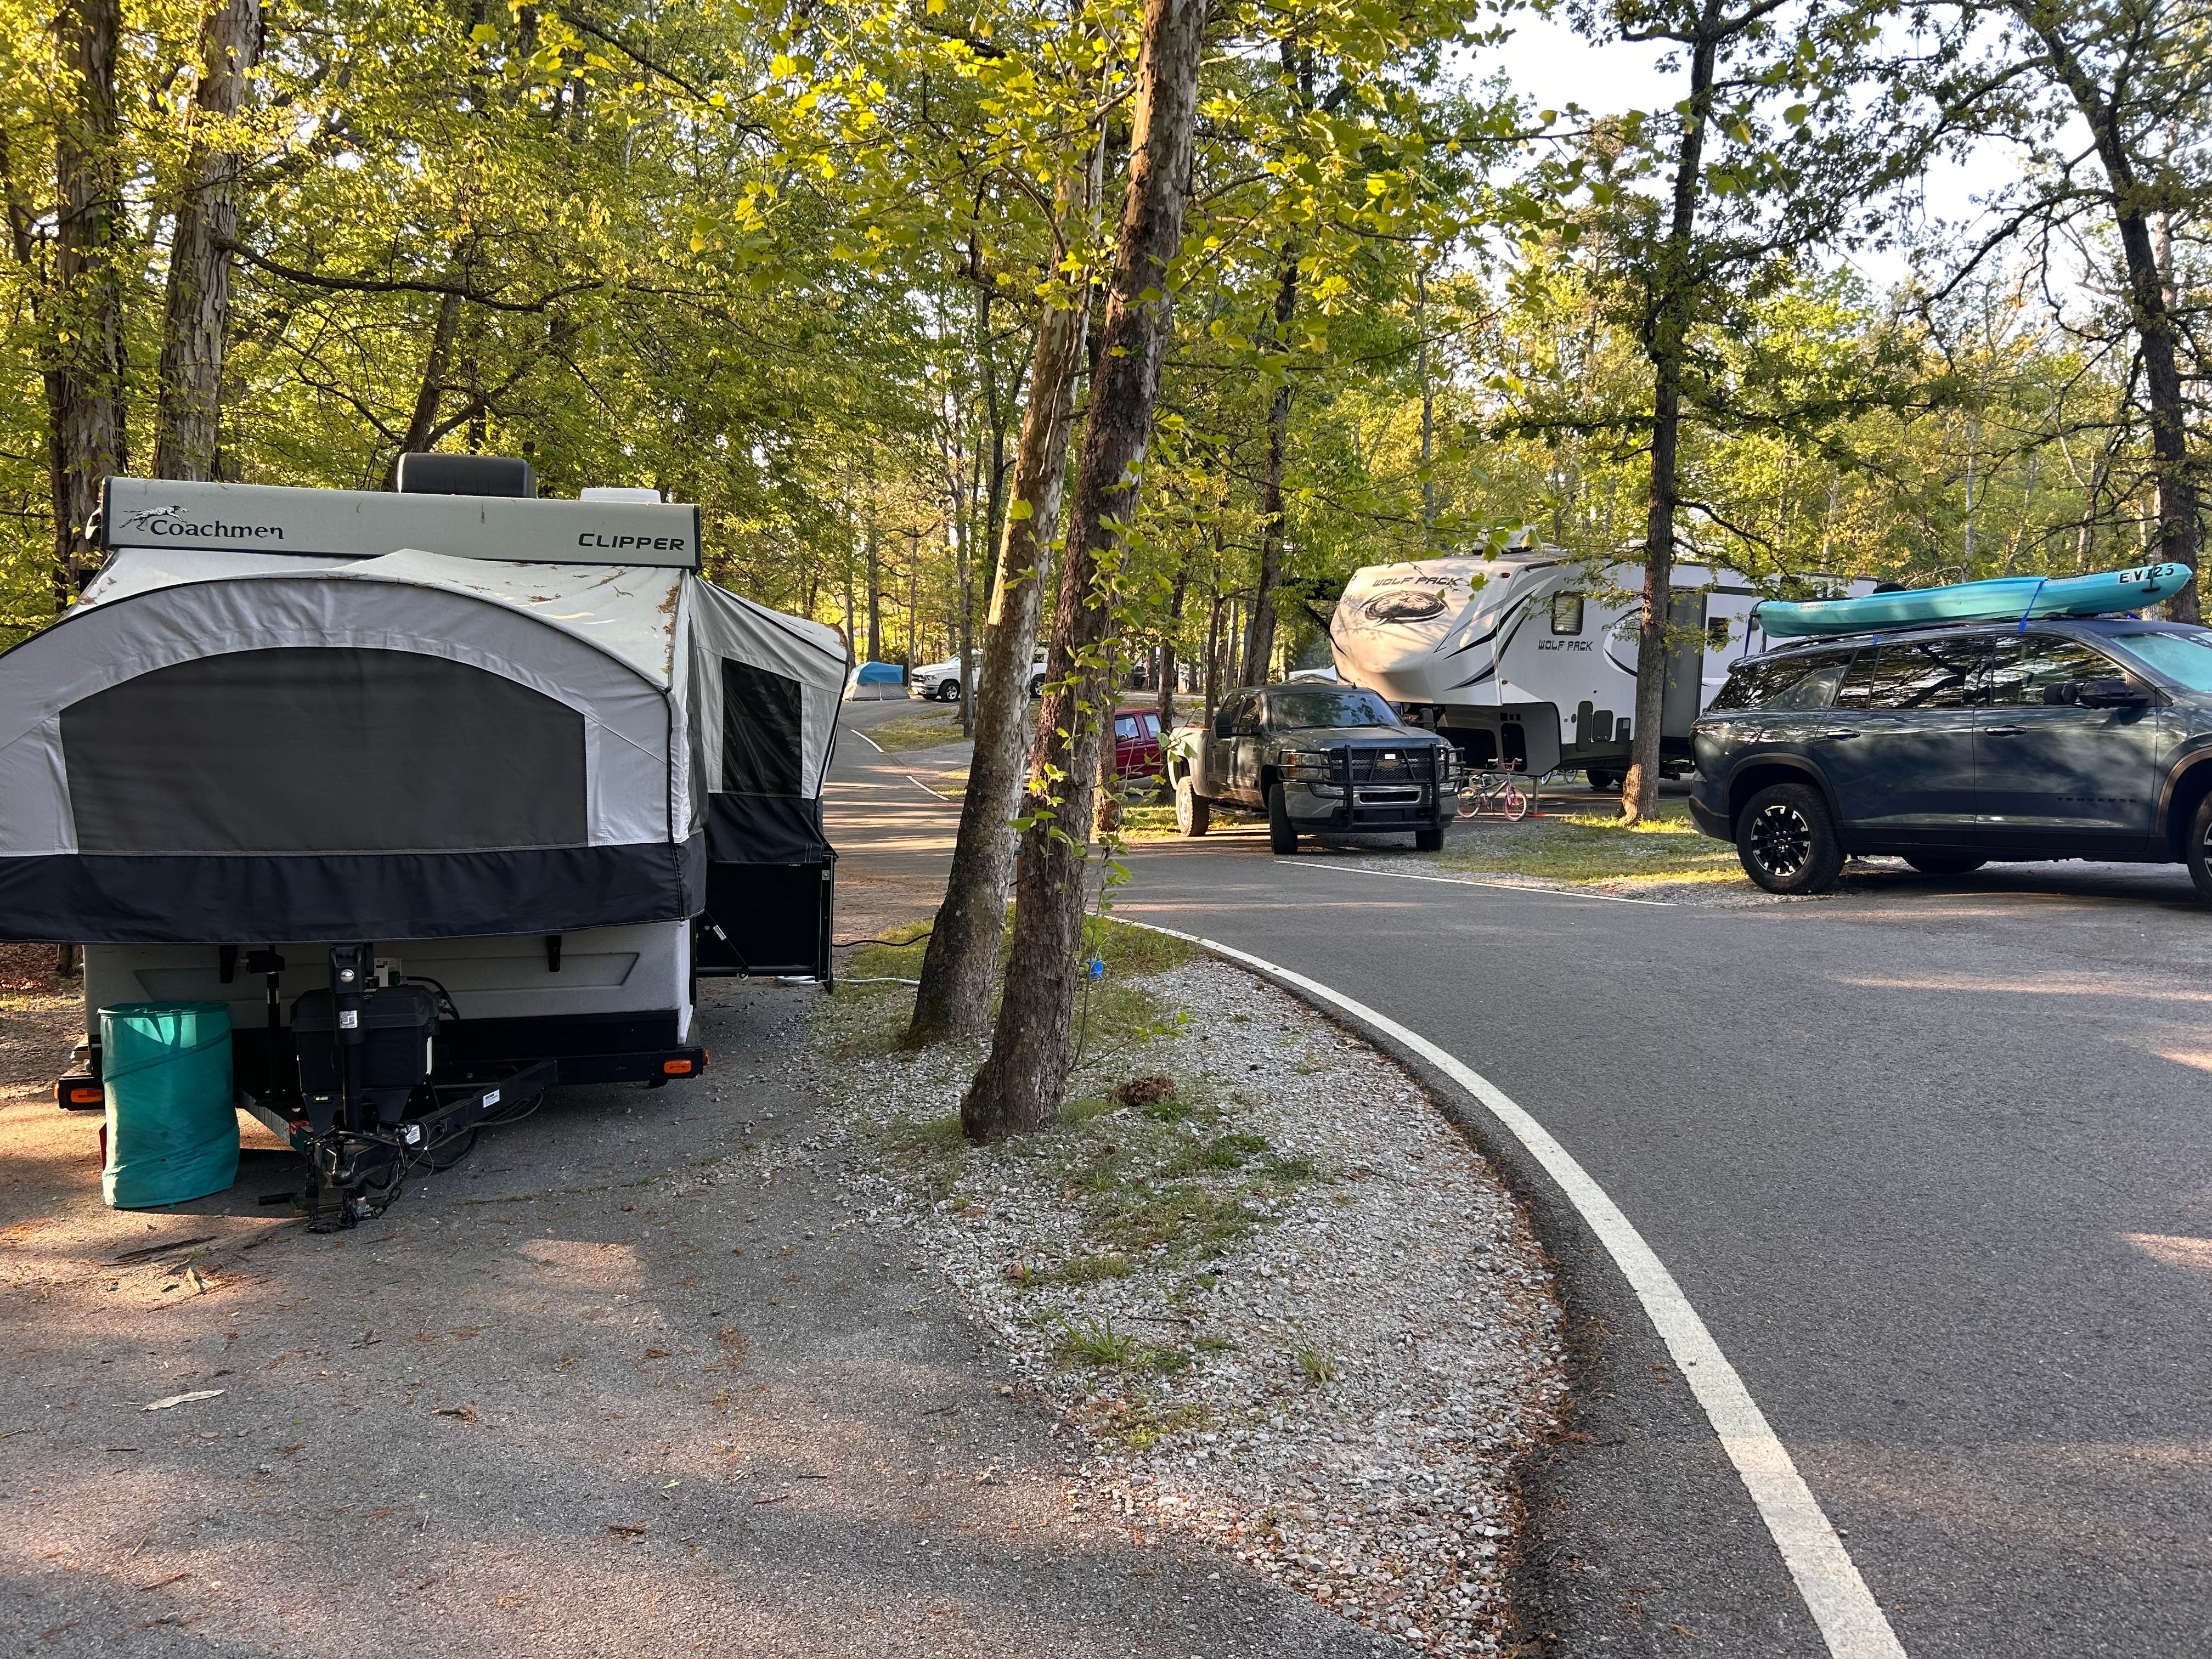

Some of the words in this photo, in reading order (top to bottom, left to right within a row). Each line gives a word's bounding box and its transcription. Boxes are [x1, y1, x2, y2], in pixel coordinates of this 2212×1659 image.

[150, 519, 284, 540] Coachmen
[578, 533, 685, 551] CLIPPER
[1372, 577, 1414, 586] WOLF
[1415, 577, 1464, 586] PACK
[1538, 640, 1565, 651] WOLF
[1567, 641, 1594, 651] PACK
